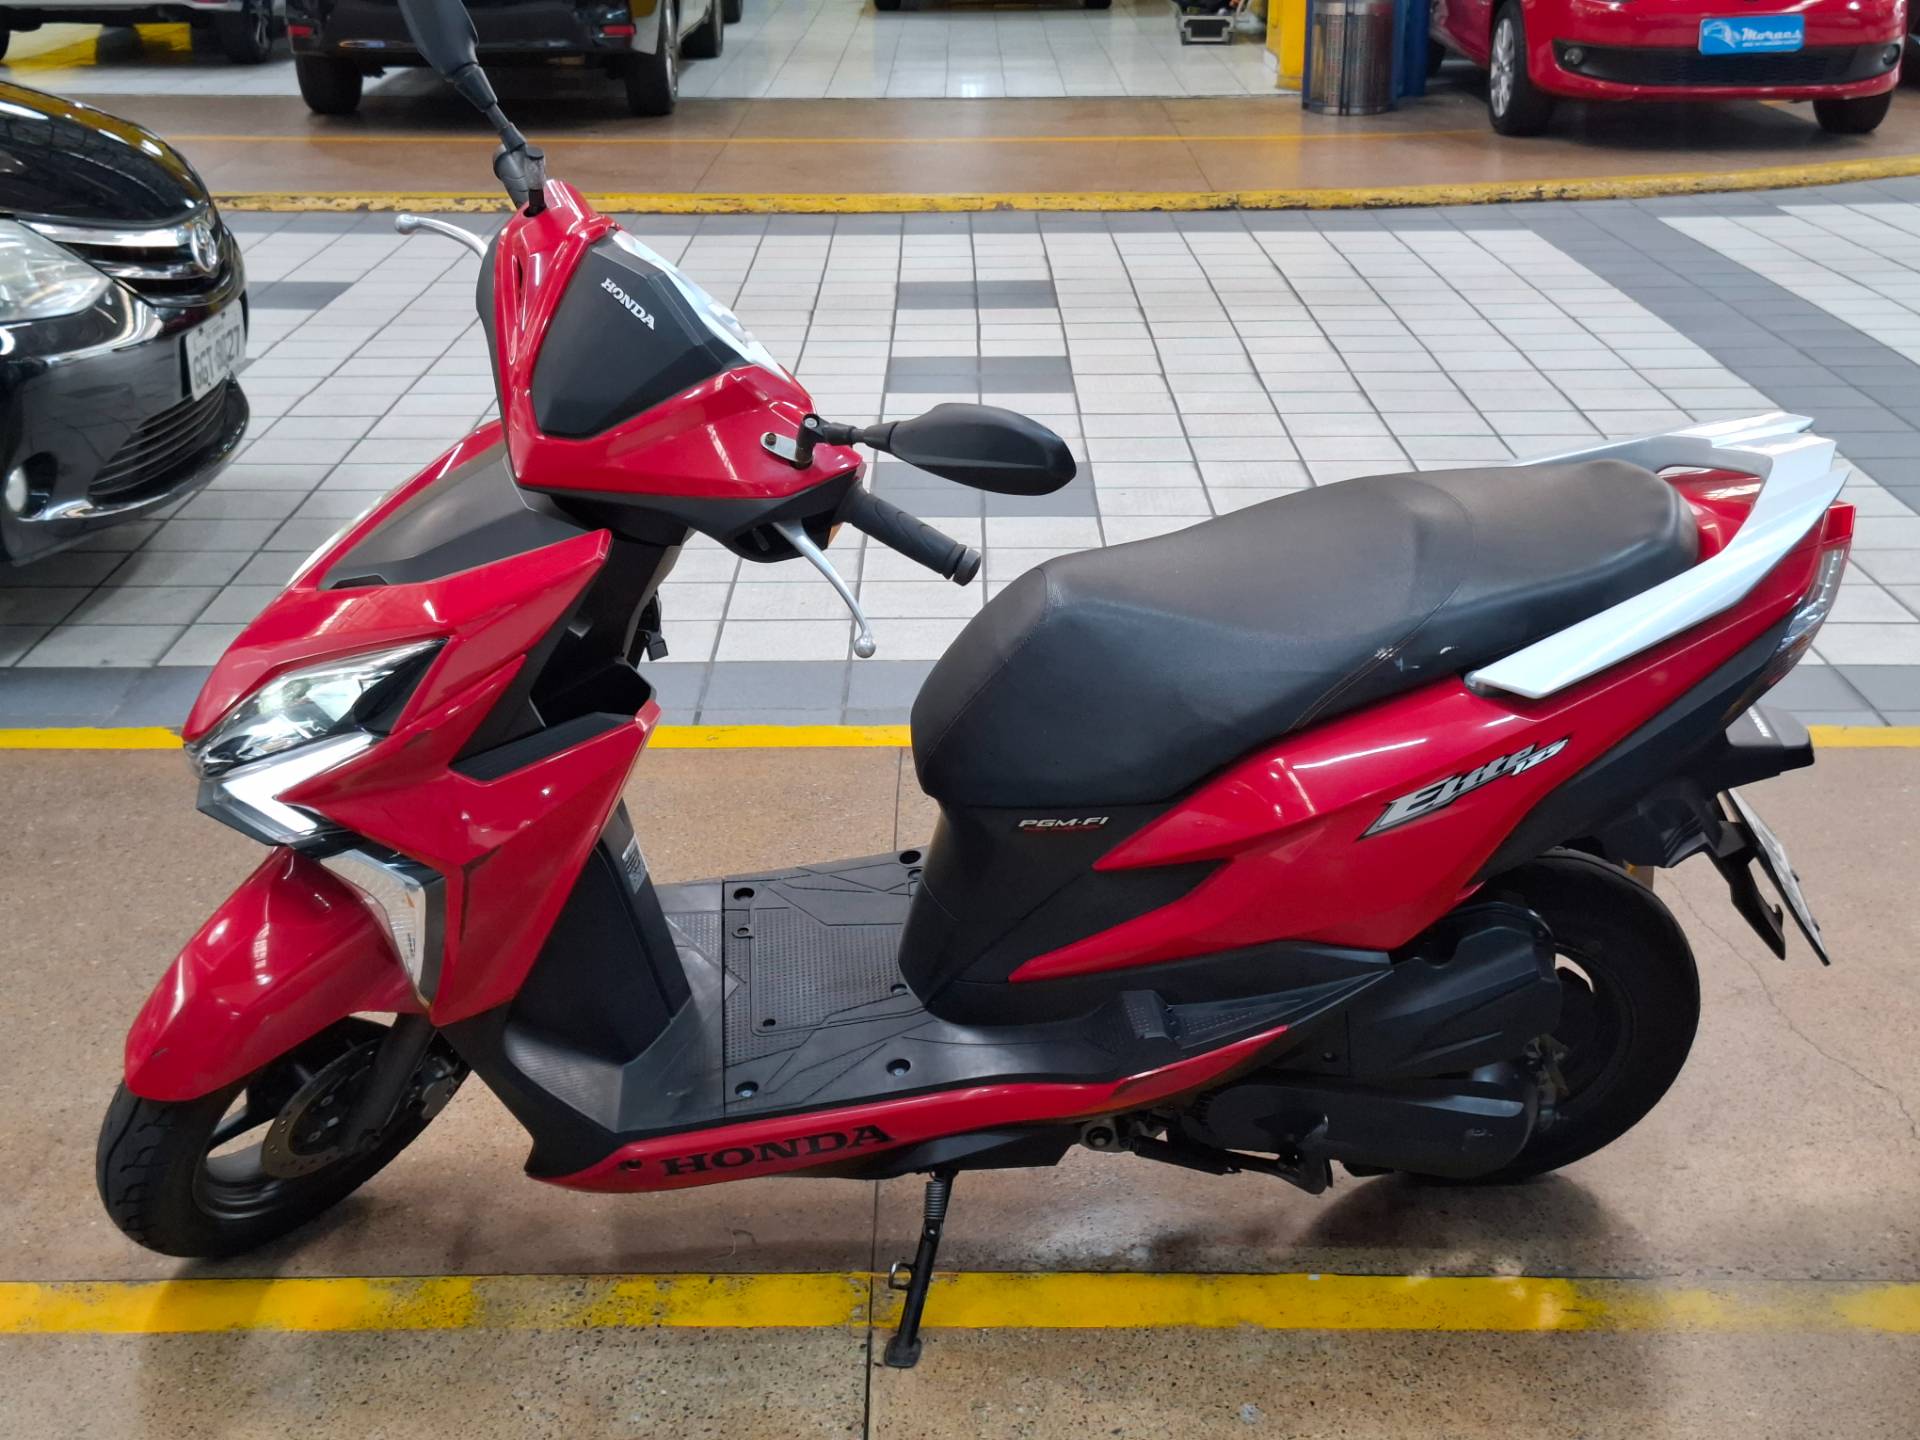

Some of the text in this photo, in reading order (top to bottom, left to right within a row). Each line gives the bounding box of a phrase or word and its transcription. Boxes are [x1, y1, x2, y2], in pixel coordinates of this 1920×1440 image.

[601, 277, 655, 330] HONDA
[1018, 816, 1109, 827] PGM-FI
[660, 1124, 895, 1177] HONDA
